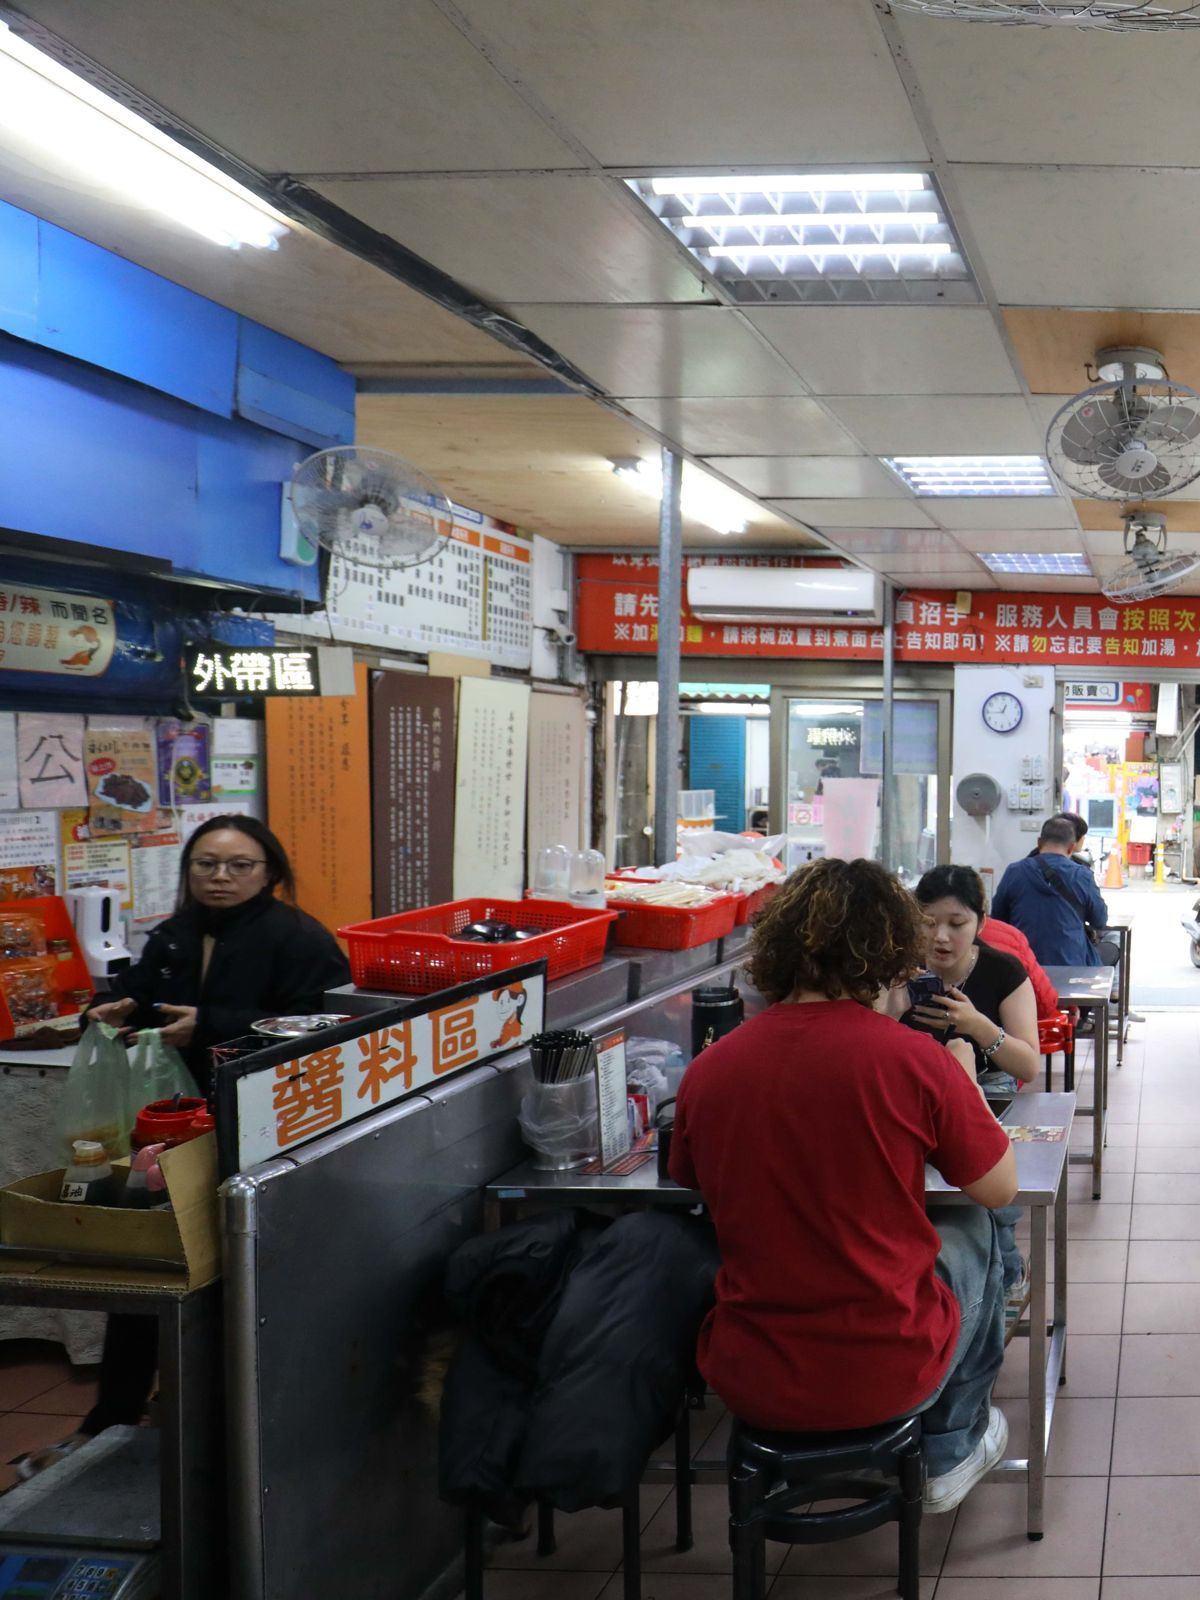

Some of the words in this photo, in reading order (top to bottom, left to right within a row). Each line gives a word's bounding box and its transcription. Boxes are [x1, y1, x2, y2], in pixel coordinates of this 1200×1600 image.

[49, 600, 107, 625] 而聞名
[193, 651, 313, 692] 外帶區
[272, 996, 479, 1148] 醬料區
